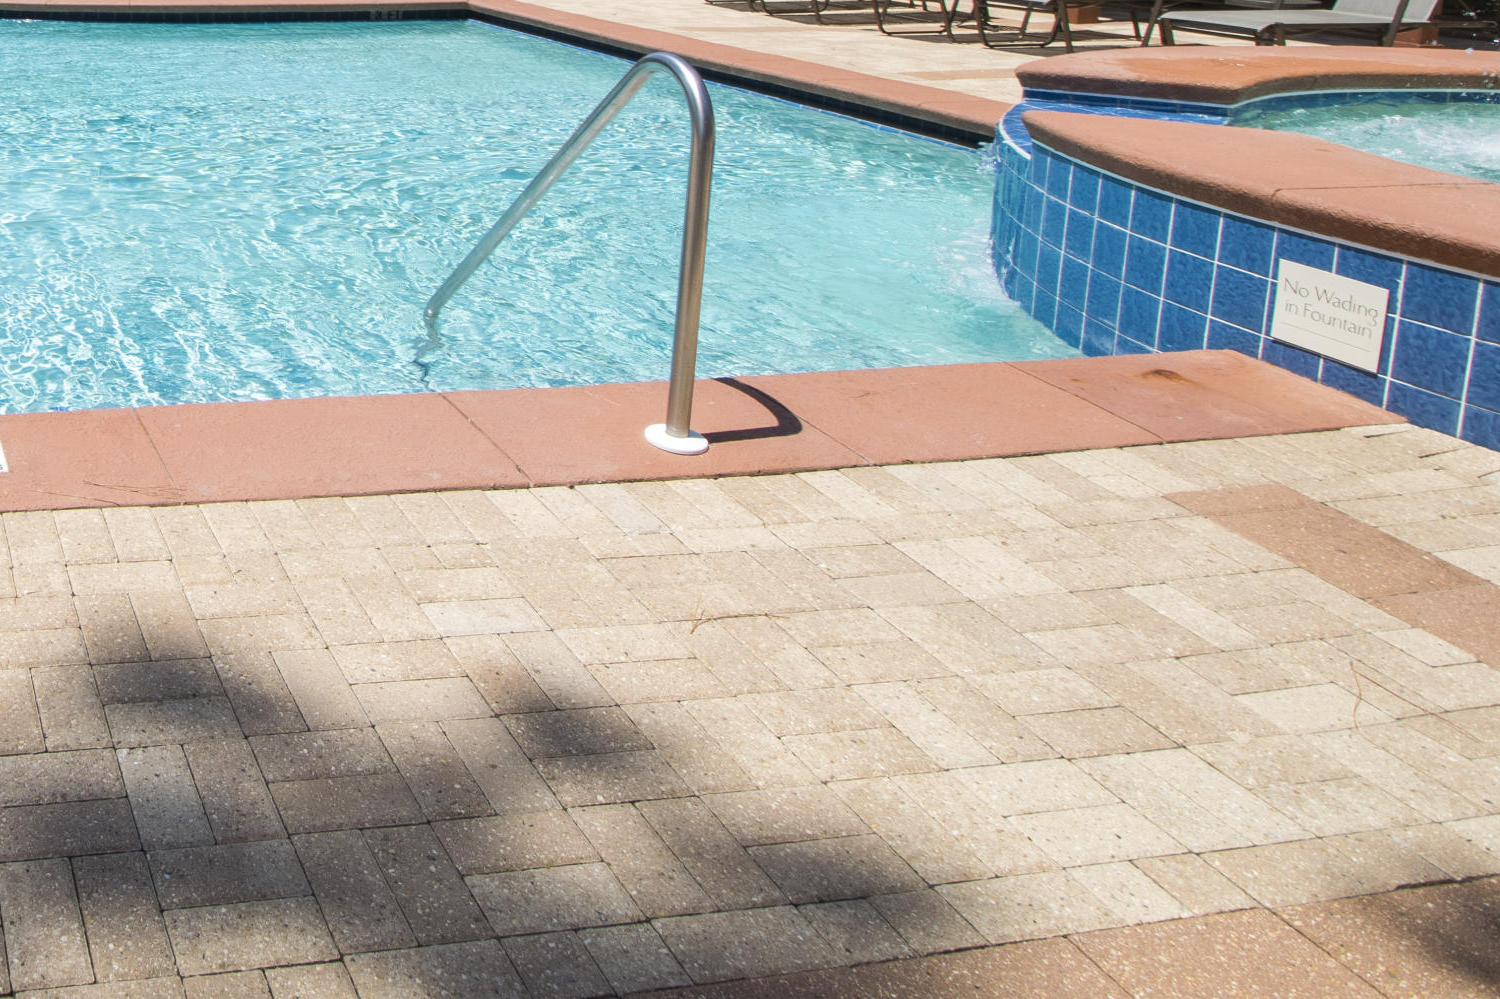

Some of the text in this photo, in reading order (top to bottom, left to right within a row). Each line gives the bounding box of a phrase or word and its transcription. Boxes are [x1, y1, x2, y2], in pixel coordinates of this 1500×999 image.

[1283, 277, 1378, 327] No Wading
[1284, 300, 1372, 339] in Fountain
